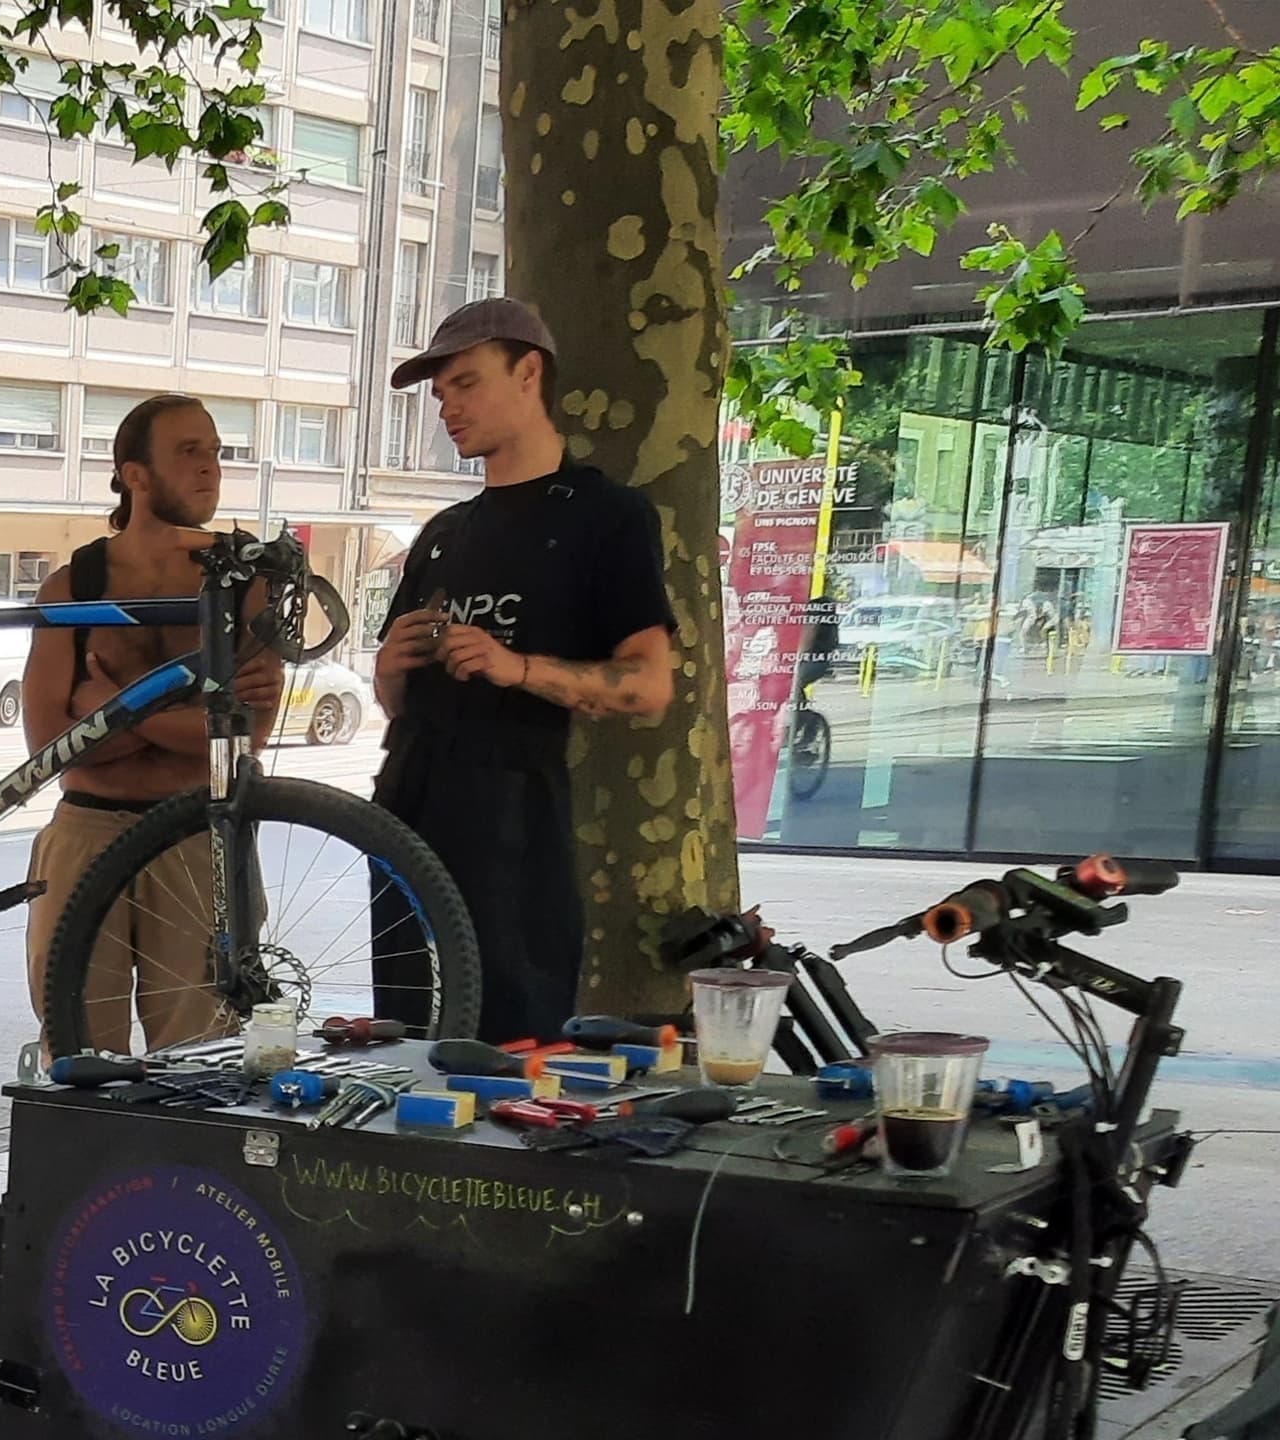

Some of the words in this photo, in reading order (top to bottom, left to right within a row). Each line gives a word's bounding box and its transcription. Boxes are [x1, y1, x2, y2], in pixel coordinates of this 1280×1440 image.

[756, 490, 780, 506] DE
[194, 1182, 258, 1231] ATELIER
[255, 1231, 291, 1300] MOBILE
[88, 1272, 115, 1308] LA
[111, 1230, 251, 1330] BICYCLETTE
[125, 1348, 203, 1383] BLEUE
[111, 1402, 192, 1437] LOCATION
[196, 1396, 258, 1435] LONGUE
